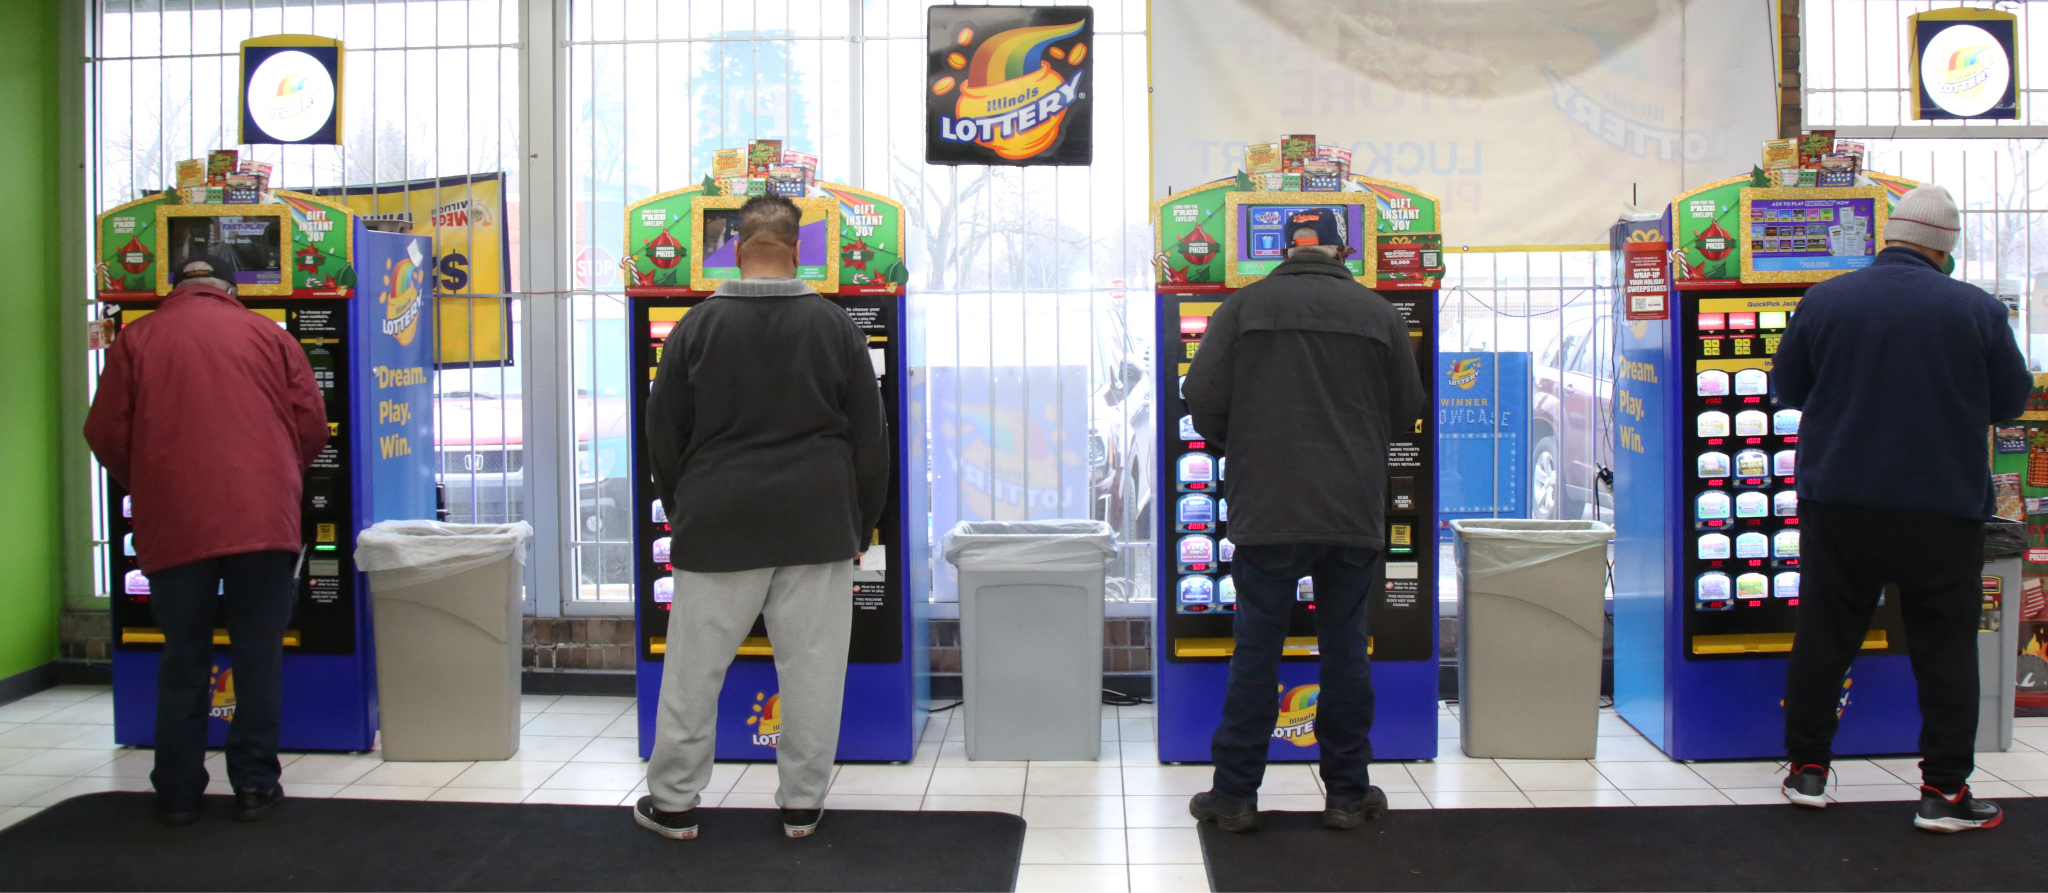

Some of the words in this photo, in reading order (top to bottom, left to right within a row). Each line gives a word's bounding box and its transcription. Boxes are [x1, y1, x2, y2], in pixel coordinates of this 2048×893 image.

[987, 86, 1039, 112] Illinois
[940, 68, 1084, 144] LOTTERY
[1390, 198, 1411, 209] GIFT
[854, 204, 876, 215] GIFT
[1382, 209, 1420, 220] INSTANT
[306, 210, 327, 221] GIFT
[431, 209, 469, 227] MEGA
[846, 215, 884, 226] INSTANT
[298, 221, 334, 231] INSTANT
[1392, 220, 1410, 231] JOY
[307, 232, 325, 242] JOY
[855, 226, 874, 237] JOY
[1188, 246, 1209, 254] PRIZES
[1706, 242, 1725, 250] PRIZES
[655, 250, 675, 258] PRIZES
[577, 260, 613, 277] STOP
[1627, 285, 1668, 293] SWEEPSTAKES
[1747, 300, 1780, 308] QuickPick
[382, 289, 423, 335] LOTTERY
[1619, 355, 1658, 384] Dream.
[378, 366, 427, 389] Dream.
[1448, 369, 1480, 387] LOTTERY
[1440, 398, 1488, 406] WINNER
[1619, 390, 1644, 422] Play.
[379, 399, 412, 426] Play.
[1439, 409, 1512, 426] OWCASE
[1620, 424, 1645, 454] Win.
[379, 433, 412, 460] Win.
[1289, 712, 1315, 724] Illinois
[1271, 718, 1316, 738] OTTE
